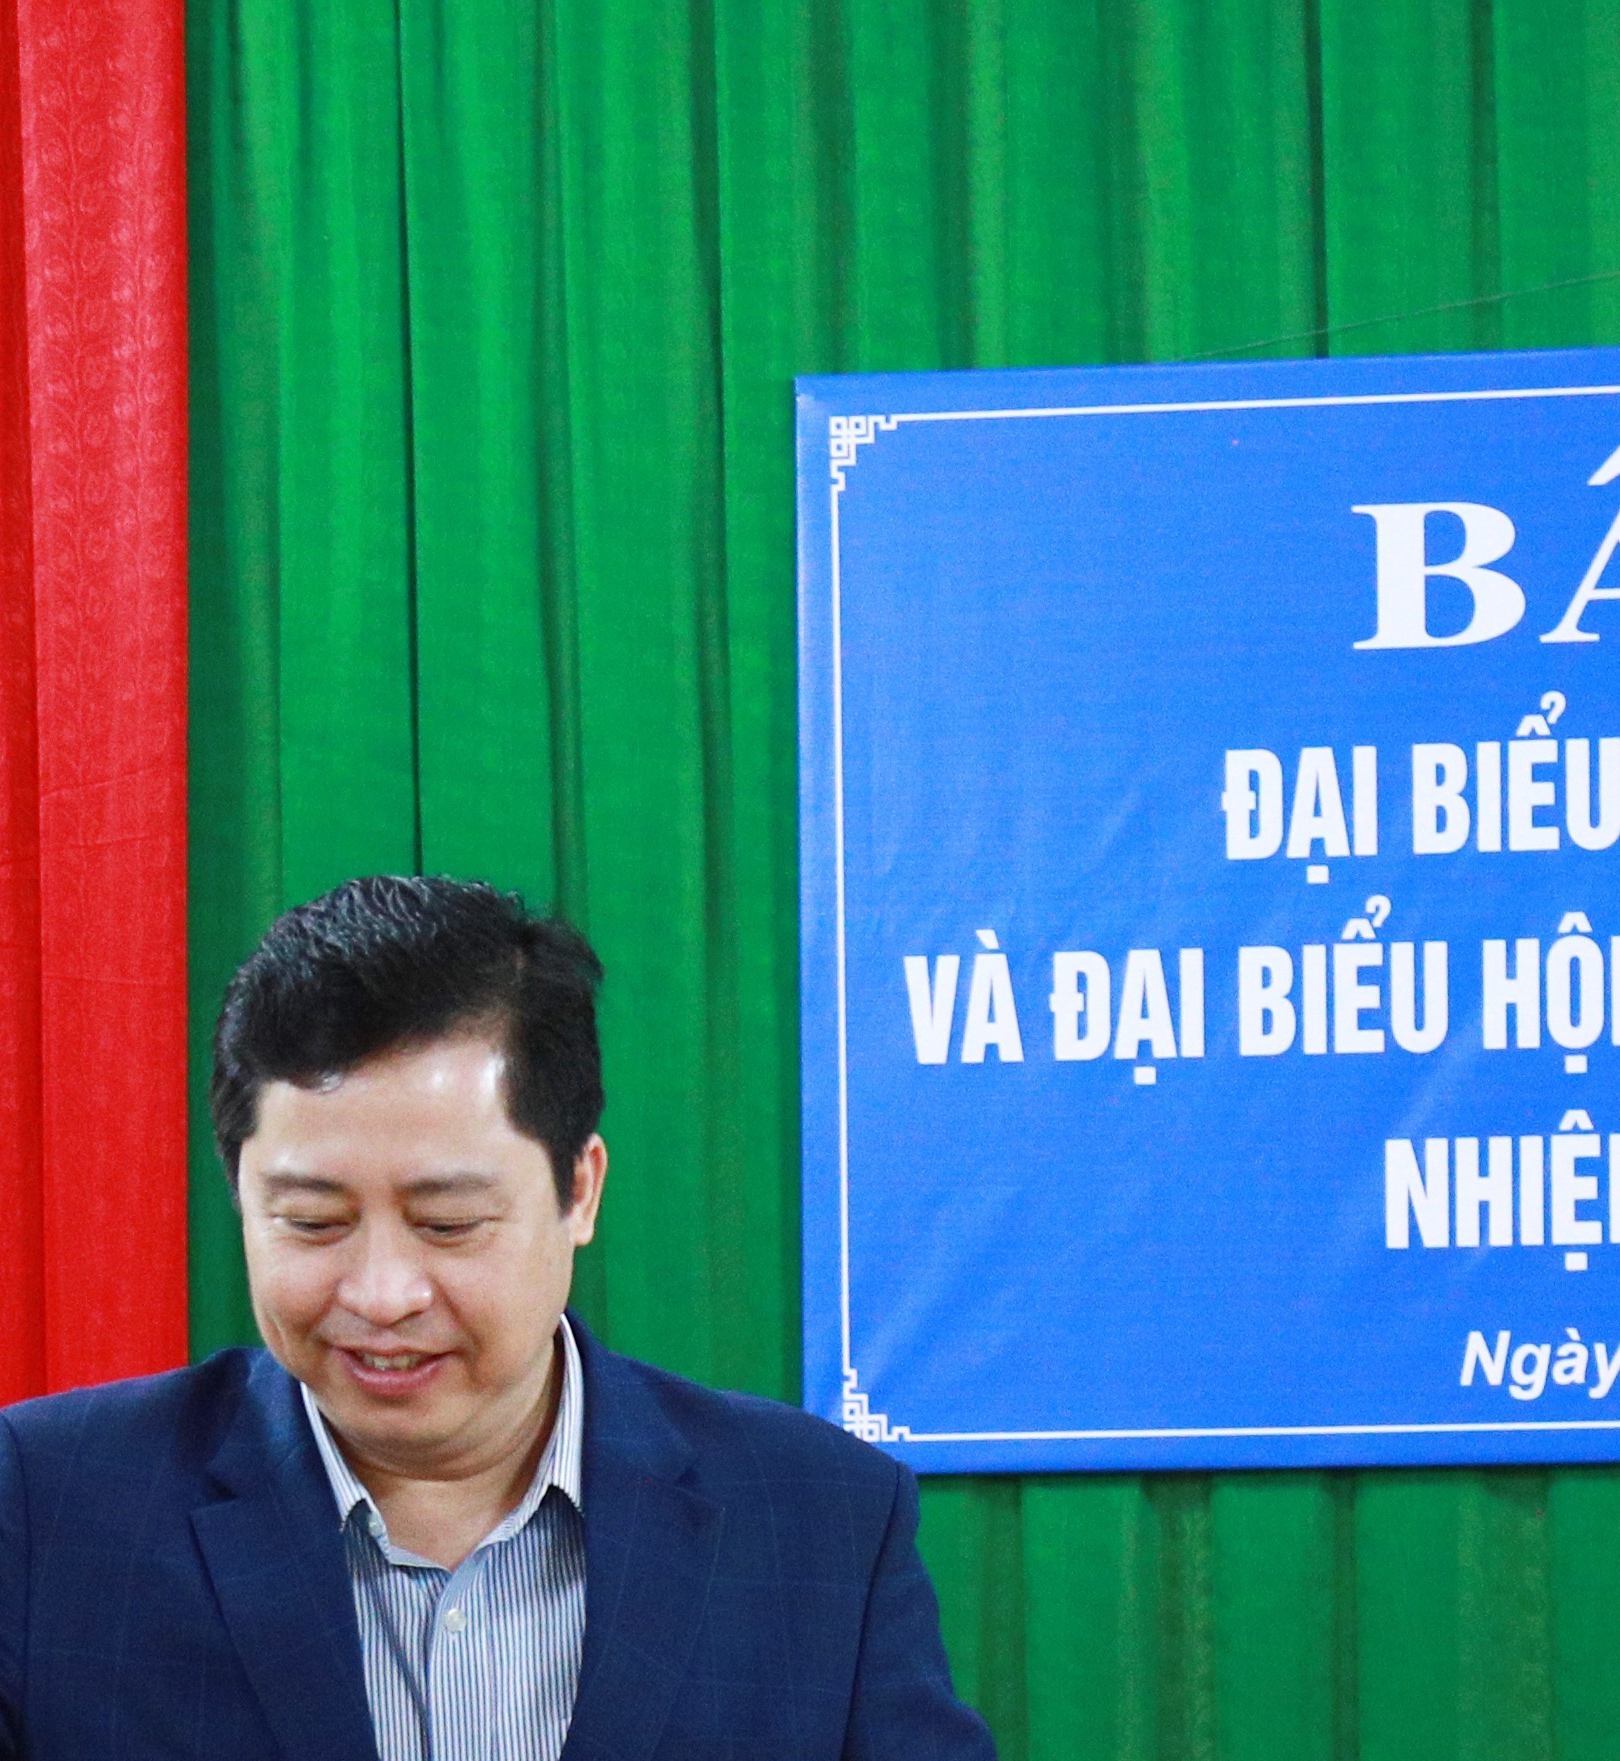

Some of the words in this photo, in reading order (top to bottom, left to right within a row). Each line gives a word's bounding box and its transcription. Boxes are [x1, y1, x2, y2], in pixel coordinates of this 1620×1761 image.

[1221, 746, 1378, 884] ĐẠI
[903, 929, 1024, 1064] VÀ
[1049, 948, 1204, 1085] ĐẠI
[1238, 895, 1448, 1056] BIỂU
